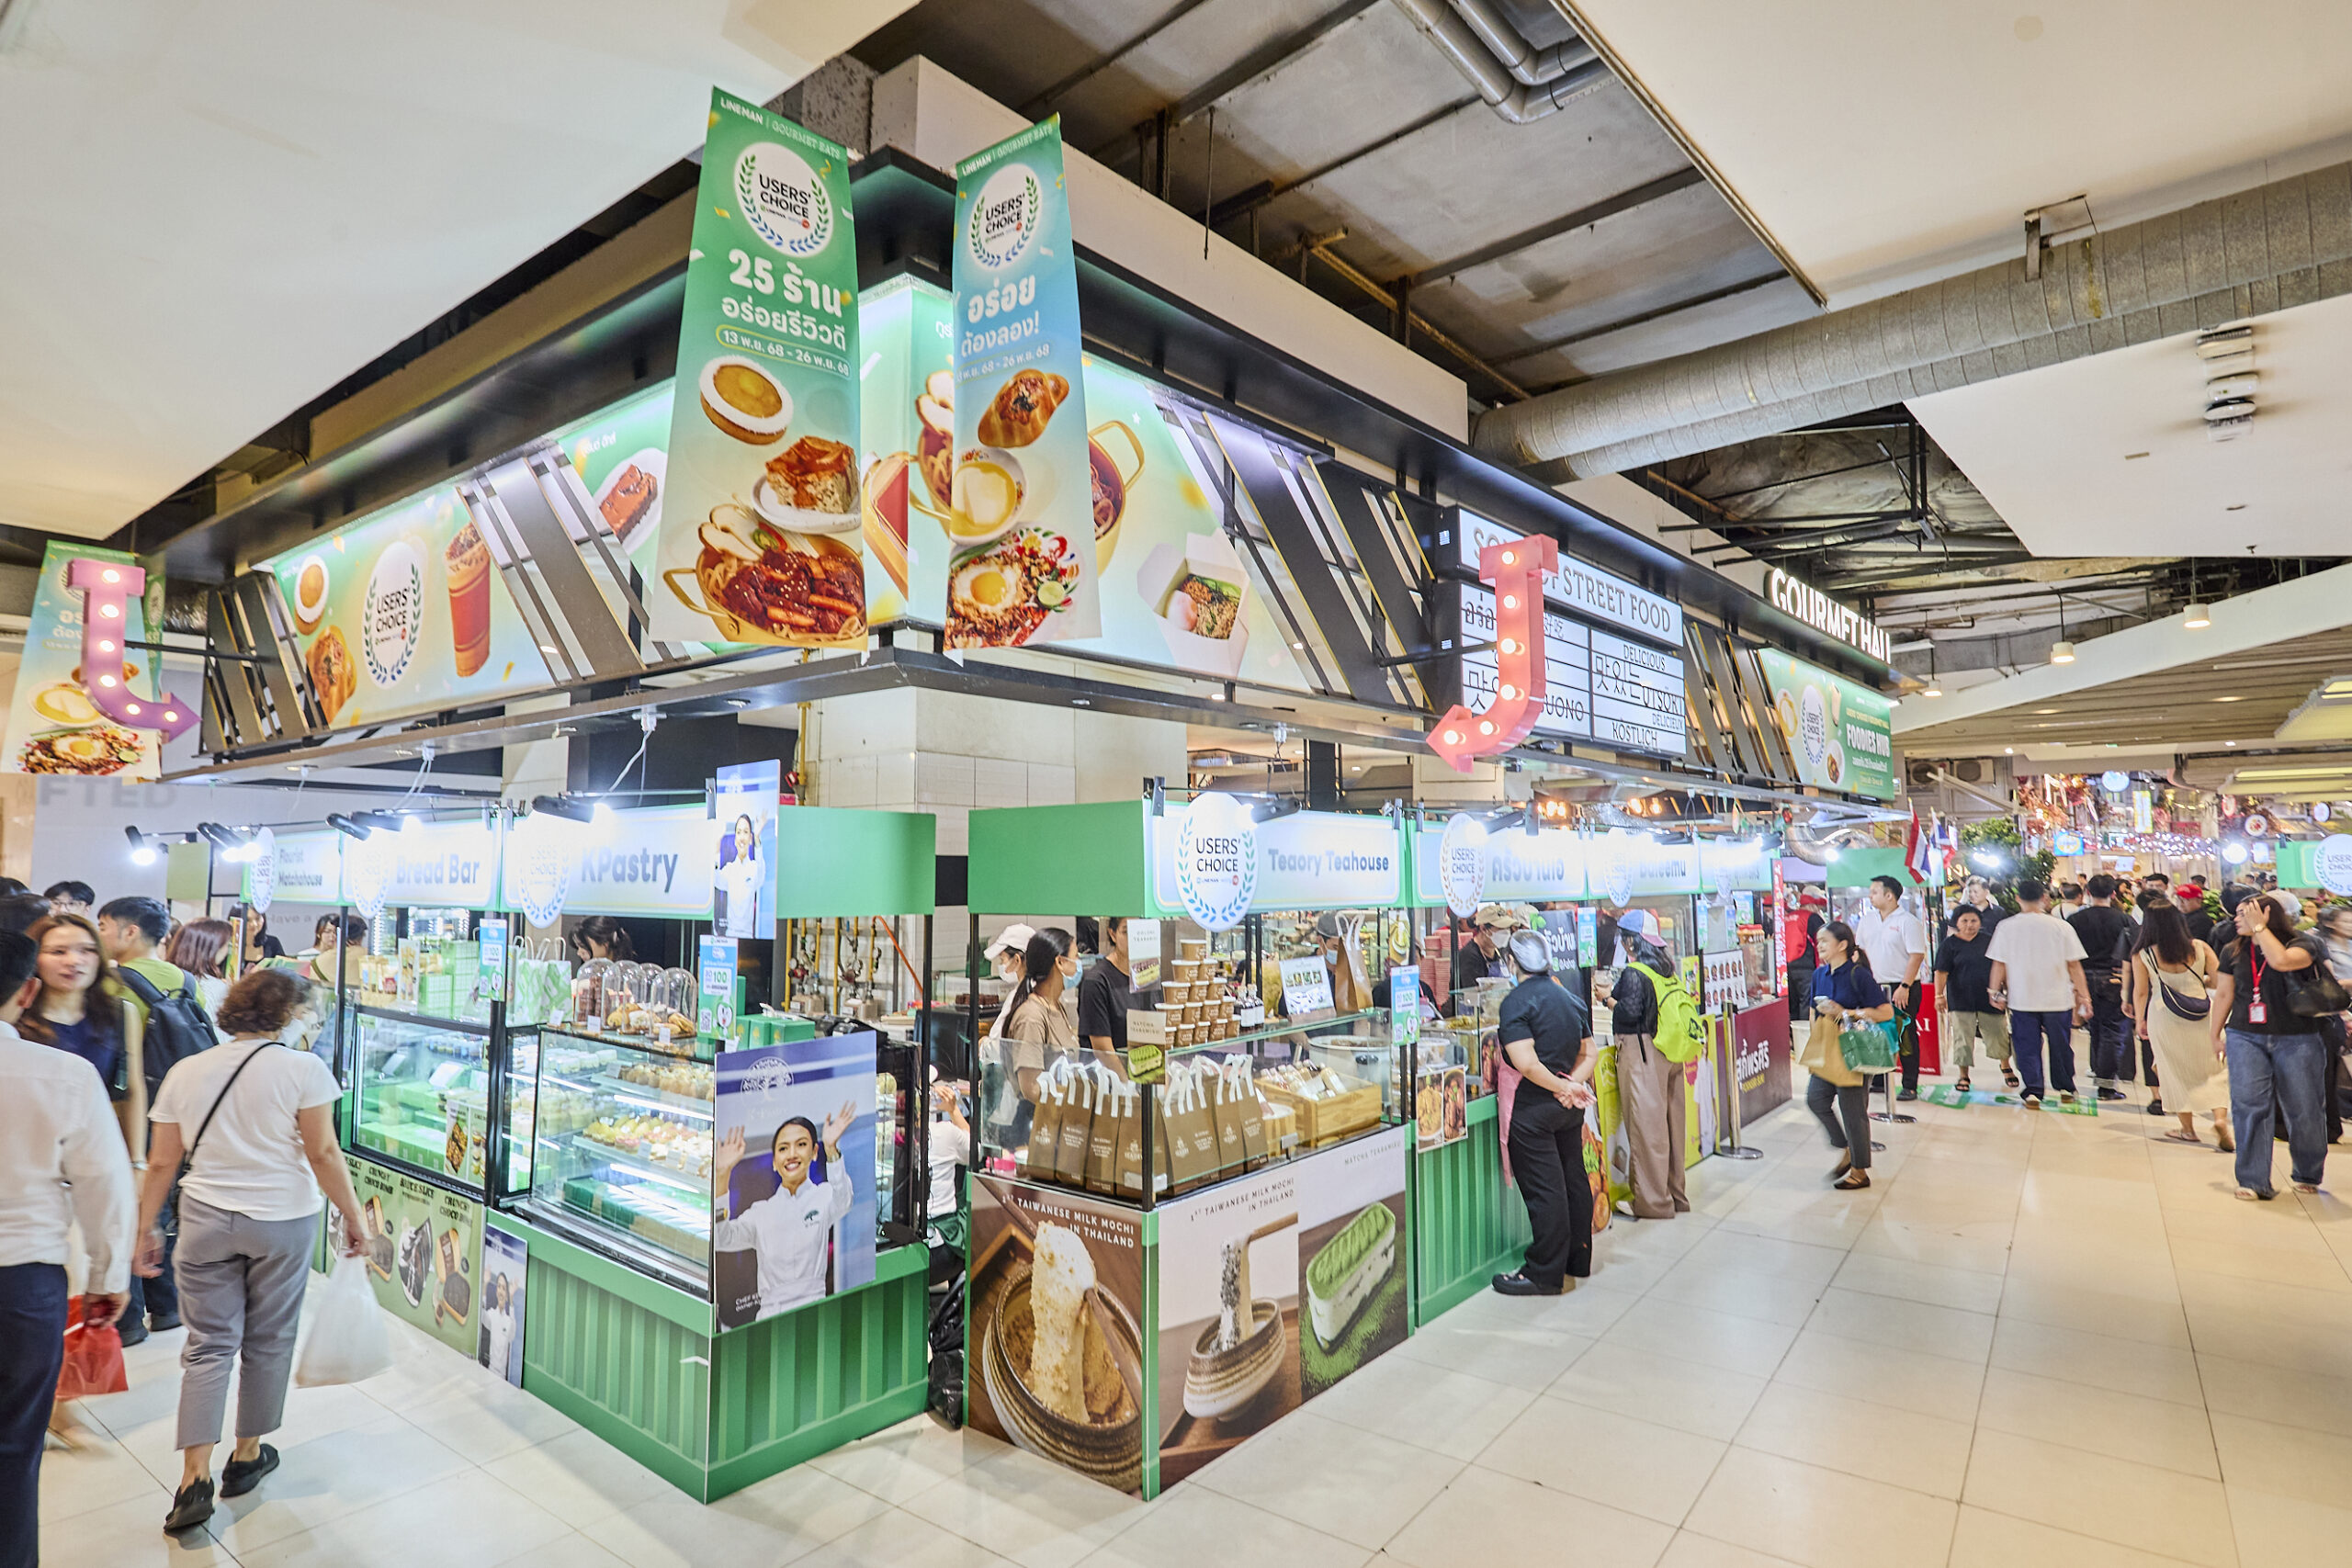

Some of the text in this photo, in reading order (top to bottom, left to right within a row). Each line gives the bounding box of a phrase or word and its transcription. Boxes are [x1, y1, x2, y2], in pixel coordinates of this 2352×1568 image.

[759, 173, 811, 205] USERS'
[760, 190, 809, 220] CHOICE
[985, 192, 1025, 221] USERS'
[985, 209, 1023, 234] CHOICE
[729, 248, 842, 318] 25 ร้าน
[967, 275, 1036, 324] อร่อย
[721, 295, 846, 352] อร่อยรีวิวดี
[961, 310, 1040, 358] ต้องลอง!
[767, 342, 785, 358] 68
[796, 349, 812, 365] 26
[837, 362, 850, 377] 68
[376, 586, 411, 614] USERS'
[1563, 564, 1671, 634] STREET FOOD
[375, 610, 407, 633] CHOICE
[1623, 644, 1666, 672] DELICIOUS
[1541, 694, 1585, 722] UONO
[1196, 837, 1241, 854] USERS'
[396, 854, 443, 886] Bread
[448, 853, 481, 885] Bar
[581, 847, 678, 894] KPastry
[1196, 858, 1238, 872] CHOICE
[1268, 848, 1389, 875] Teaory Teahouse
[1452, 863, 1476, 874] CHOICE
[713, 971, 728, 984] 100
[1204, 1193, 1250, 1217] TAIWANESE
[1251, 1186, 1270, 1200] MILK
[1272, 1177, 1295, 1193] MOCHI
[1248, 1189, 1295, 1213] IN THAILAND
[1017, 1197, 1070, 1221] TAIWANESE
[1073, 1211, 1098, 1226] MILK
[1101, 1218, 1135, 1235] MOCHI
[1069, 1224, 1135, 1249] IN THAILAND
